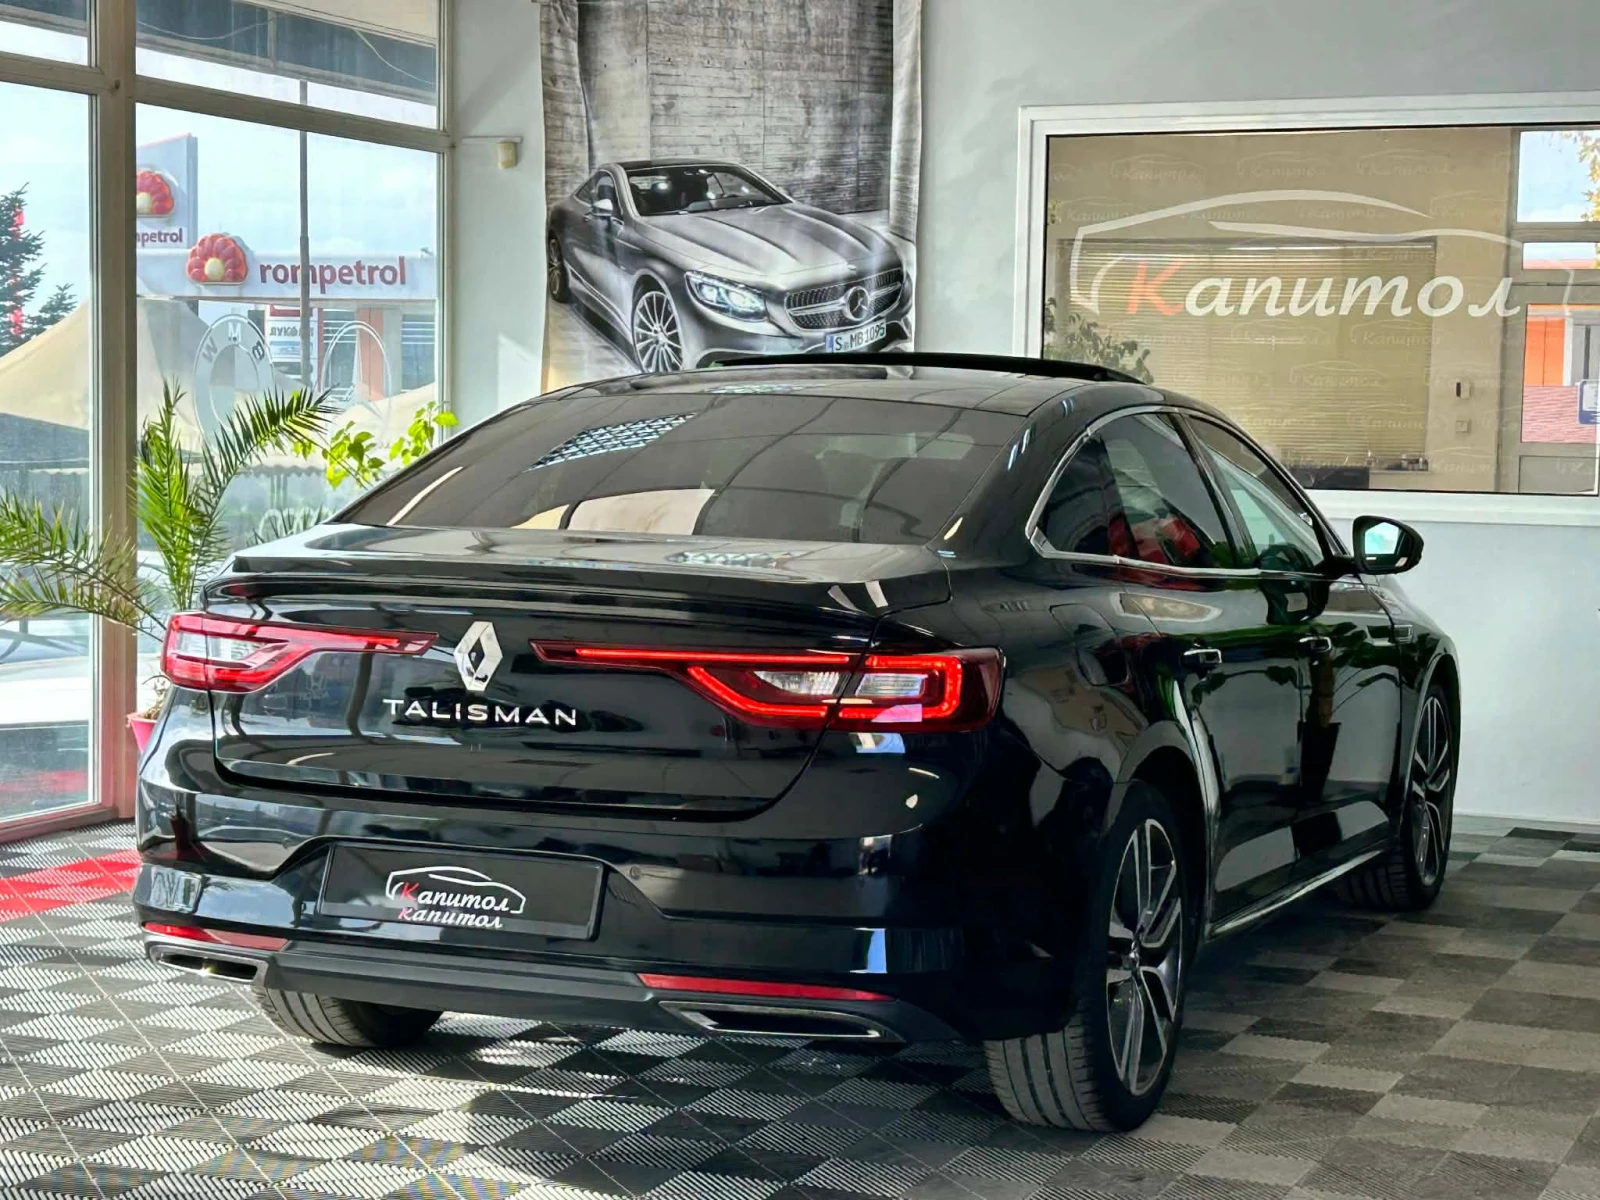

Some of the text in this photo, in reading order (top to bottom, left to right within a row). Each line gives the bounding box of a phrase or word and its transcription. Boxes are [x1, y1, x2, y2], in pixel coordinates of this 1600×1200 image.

[259, 256, 407, 294] rompetrol
[1124, 260, 1521, 317] Капитол
[382, 698, 578, 727] TALISMAN
[399, 881, 511, 912] Капитол
